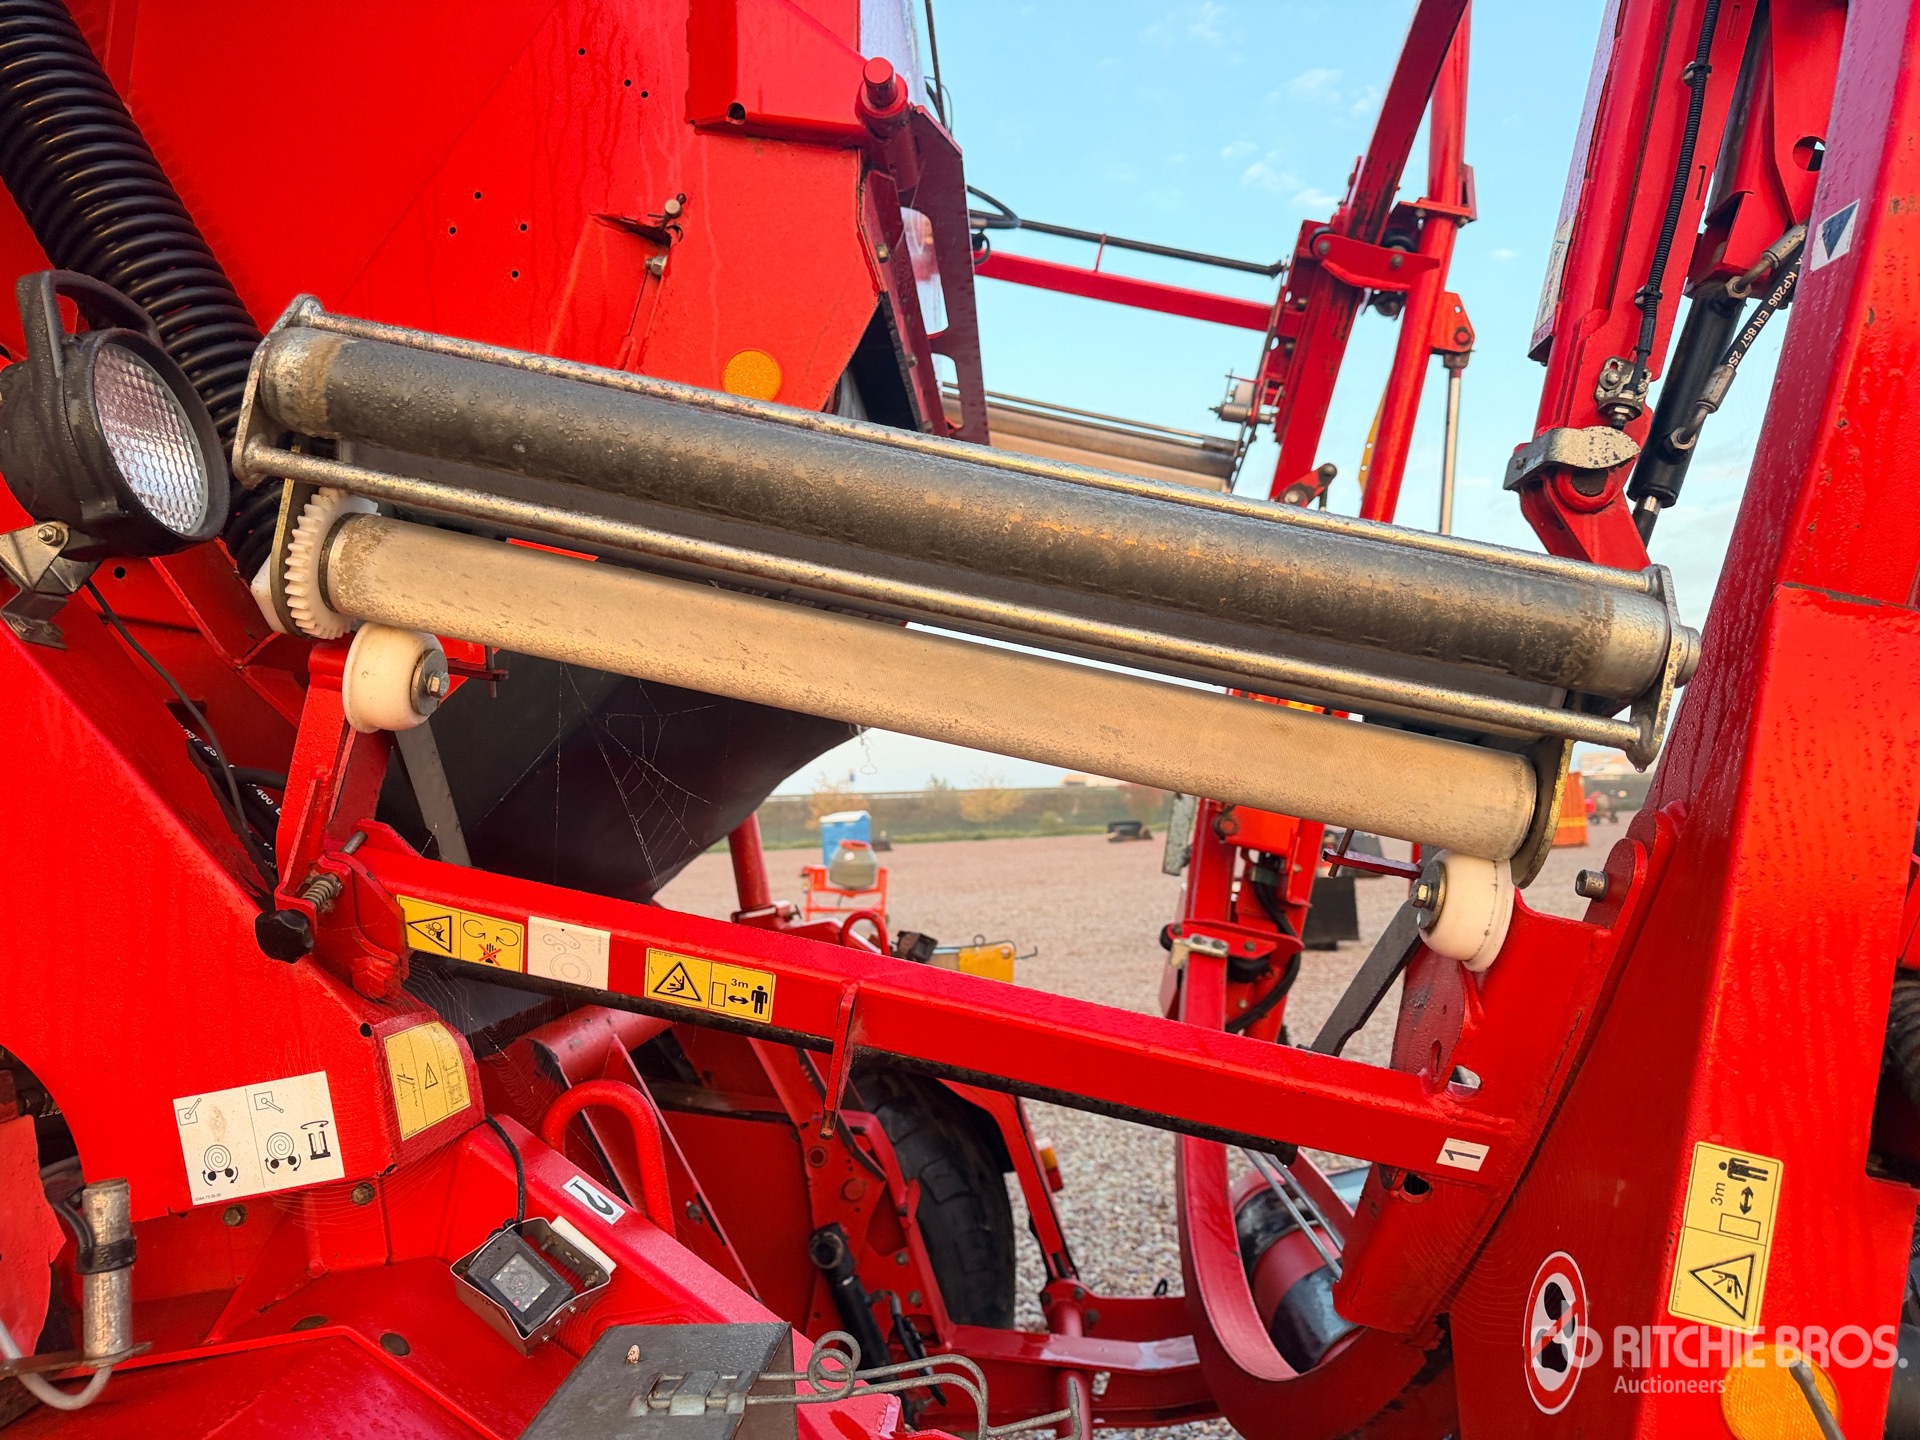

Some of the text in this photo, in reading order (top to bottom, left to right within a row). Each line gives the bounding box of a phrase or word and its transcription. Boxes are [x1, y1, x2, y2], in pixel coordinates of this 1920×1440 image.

[1768, 271, 1798, 307] KP206
[1753, 310, 1770, 328] EN
[1741, 327, 1756, 348] 857
[256, 788, 274, 806] 400
[731, 979, 748, 988] 3m
[1710, 1182, 1726, 1206] 3m
